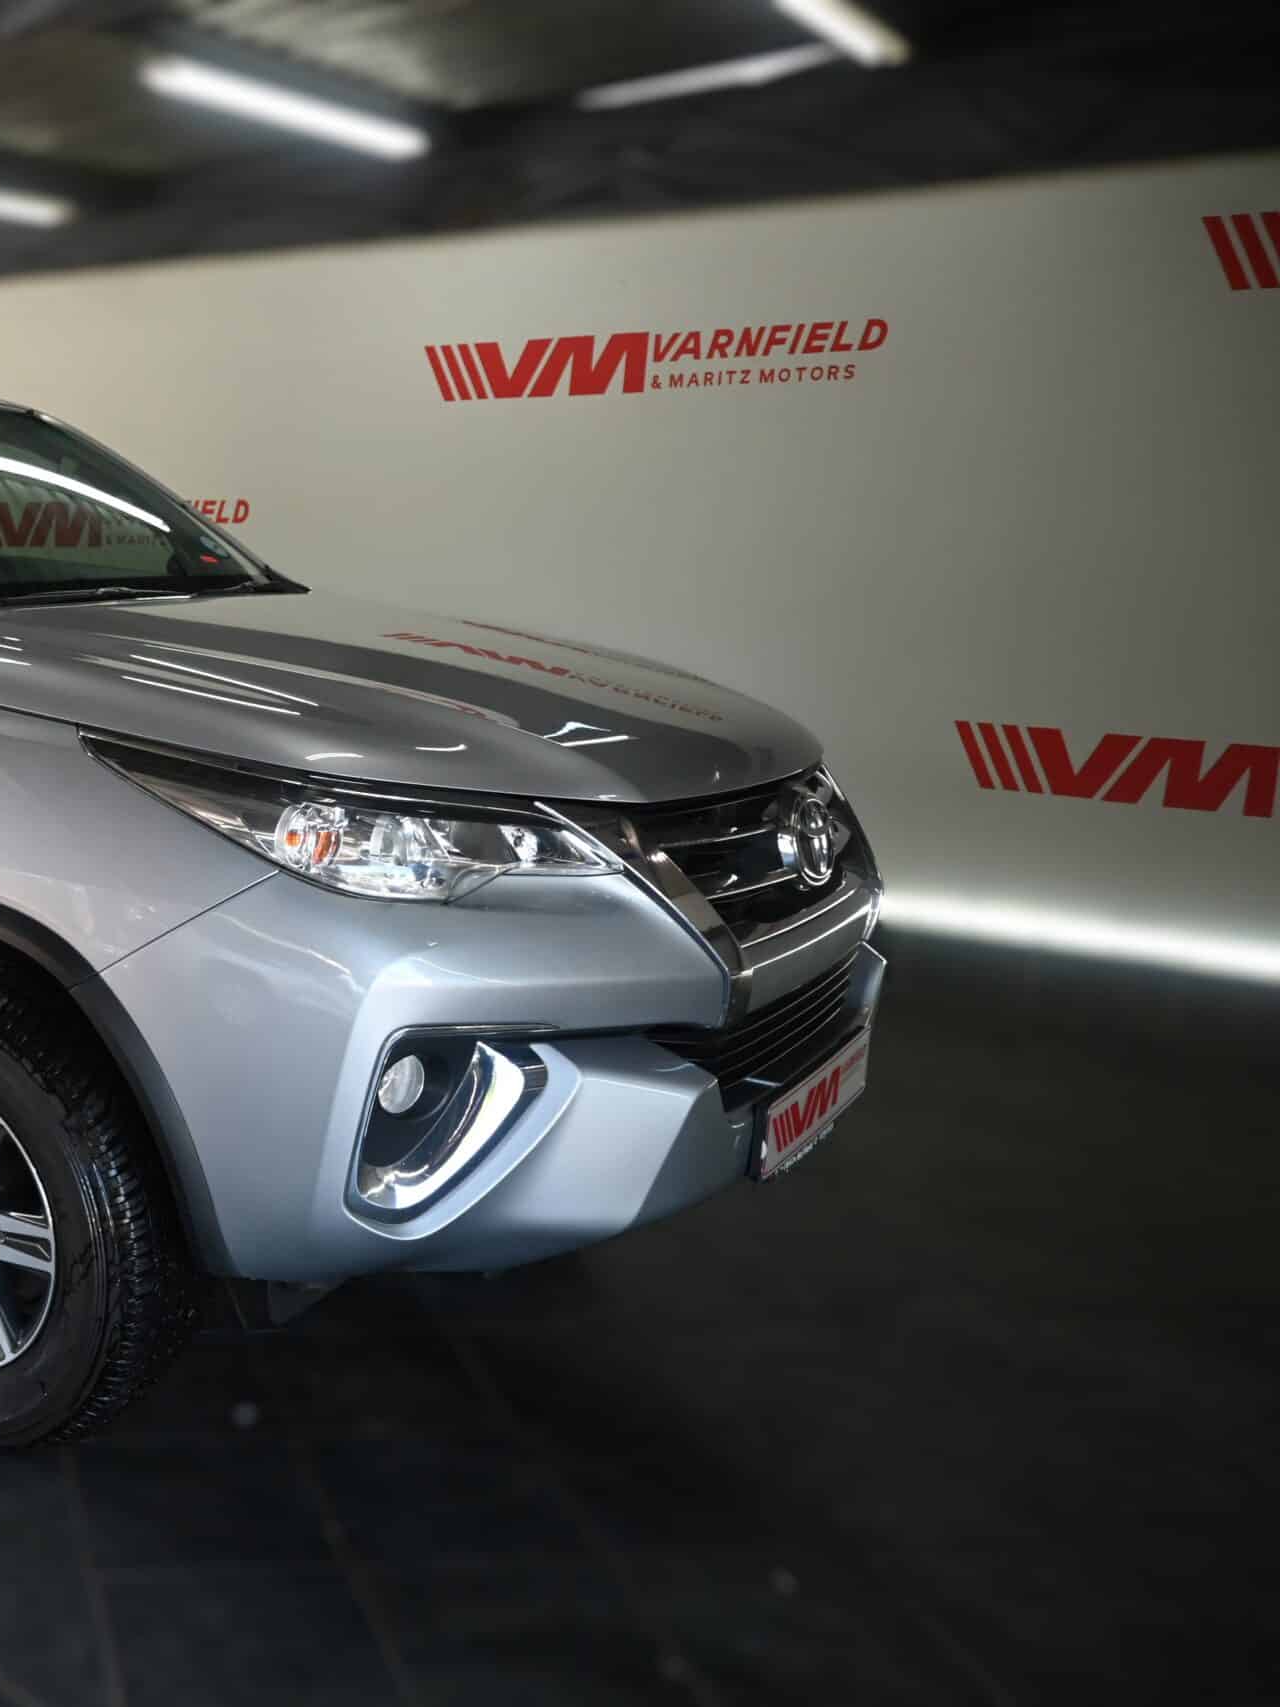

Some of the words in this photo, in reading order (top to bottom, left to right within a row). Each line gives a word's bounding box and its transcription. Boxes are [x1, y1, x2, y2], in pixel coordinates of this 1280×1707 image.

[474, 331, 650, 400] VM
[652, 317, 889, 363] VARNFIELD
[651, 374, 662, 390] &
[669, 369, 751, 389] MARITZ
[758, 364, 856, 384] MOTORS
[1026, 725, 1280, 819] VM
[789, 1066, 842, 1138] VM
